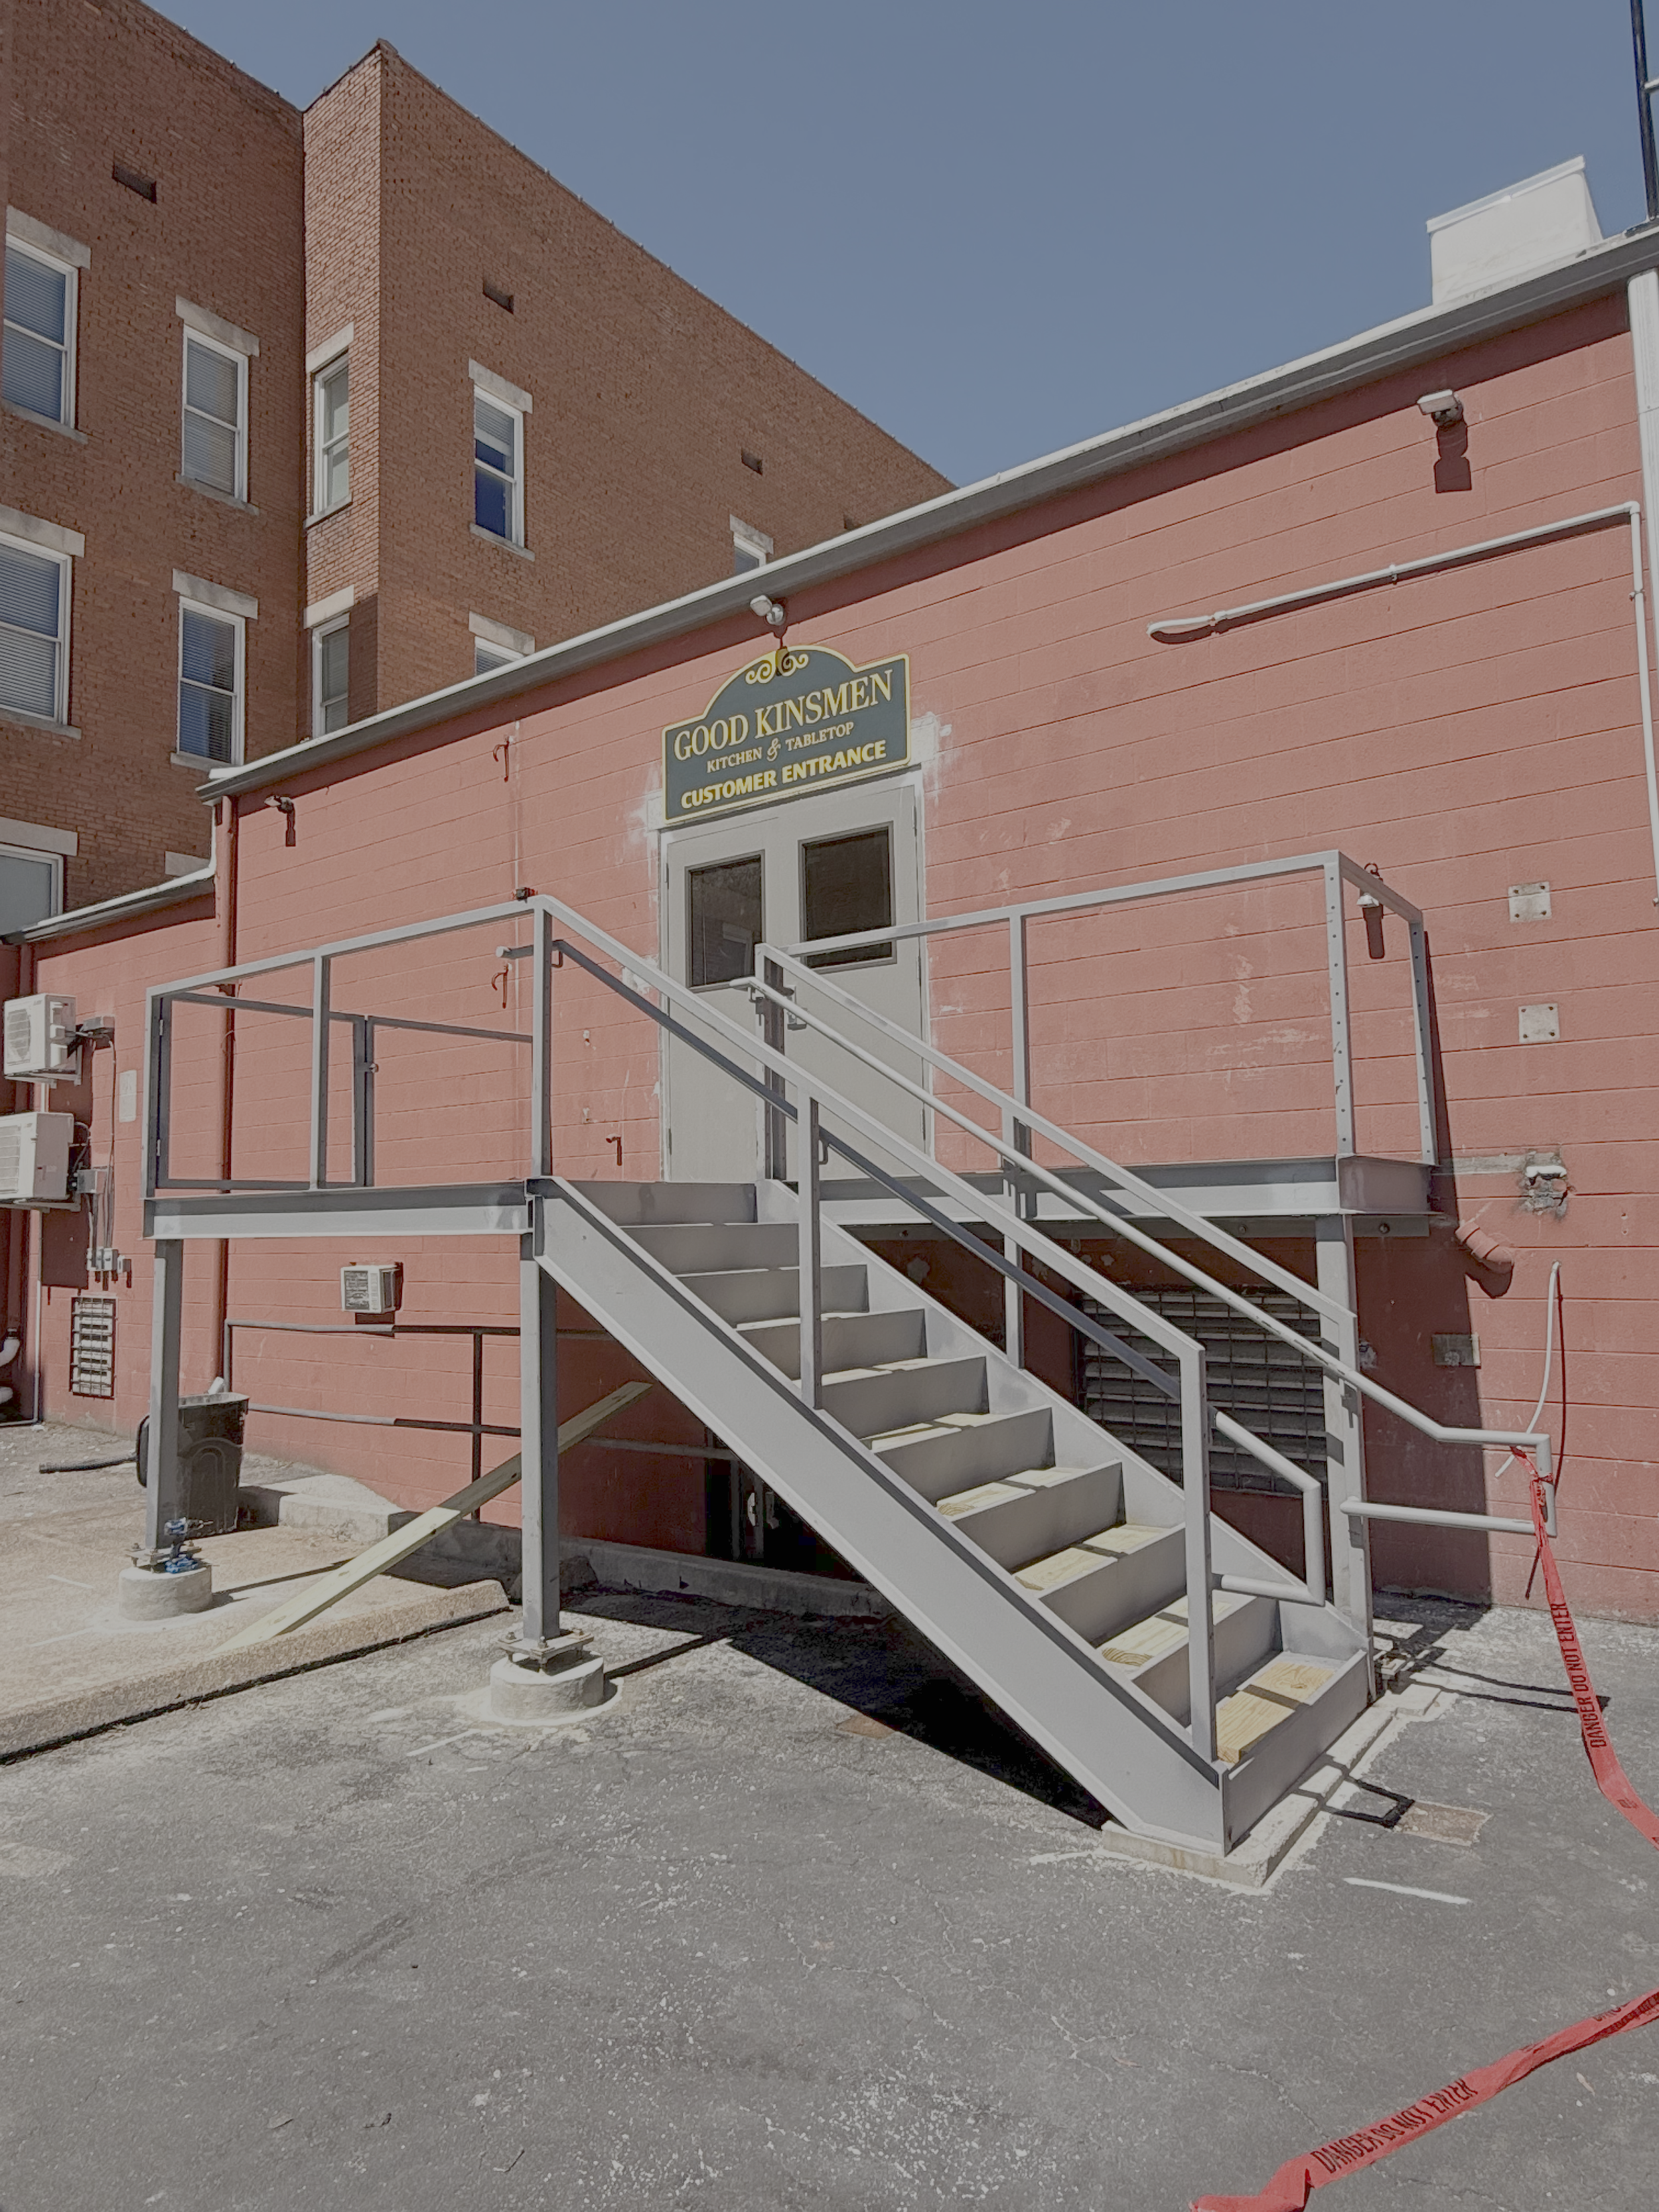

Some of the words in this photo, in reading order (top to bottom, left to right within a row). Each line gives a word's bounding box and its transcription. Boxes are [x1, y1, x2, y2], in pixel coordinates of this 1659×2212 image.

[674, 713, 749, 761] GOOD
[755, 669, 893, 739] KINSMEN
[706, 747, 762, 773] KITCHEN
[766, 737, 781, 762] &
[785, 721, 854, 751] TABLETOP
[680, 770, 777, 809] CUSTOMER
[782, 740, 887, 784] ENTRANCE
[1550, 1602, 1575, 1643] ENTER
[1561, 1646, 1583, 1671] NOT
[1571, 1674, 1589, 1692] DO
[1577, 1696, 1607, 1748] DANGER
[1310, 2133, 1384, 2174] DANGER
[1370, 2124, 1405, 2140] DO
[1391, 2104, 1434, 2130] NOT
[1421, 2078, 1479, 2114] ENTER
